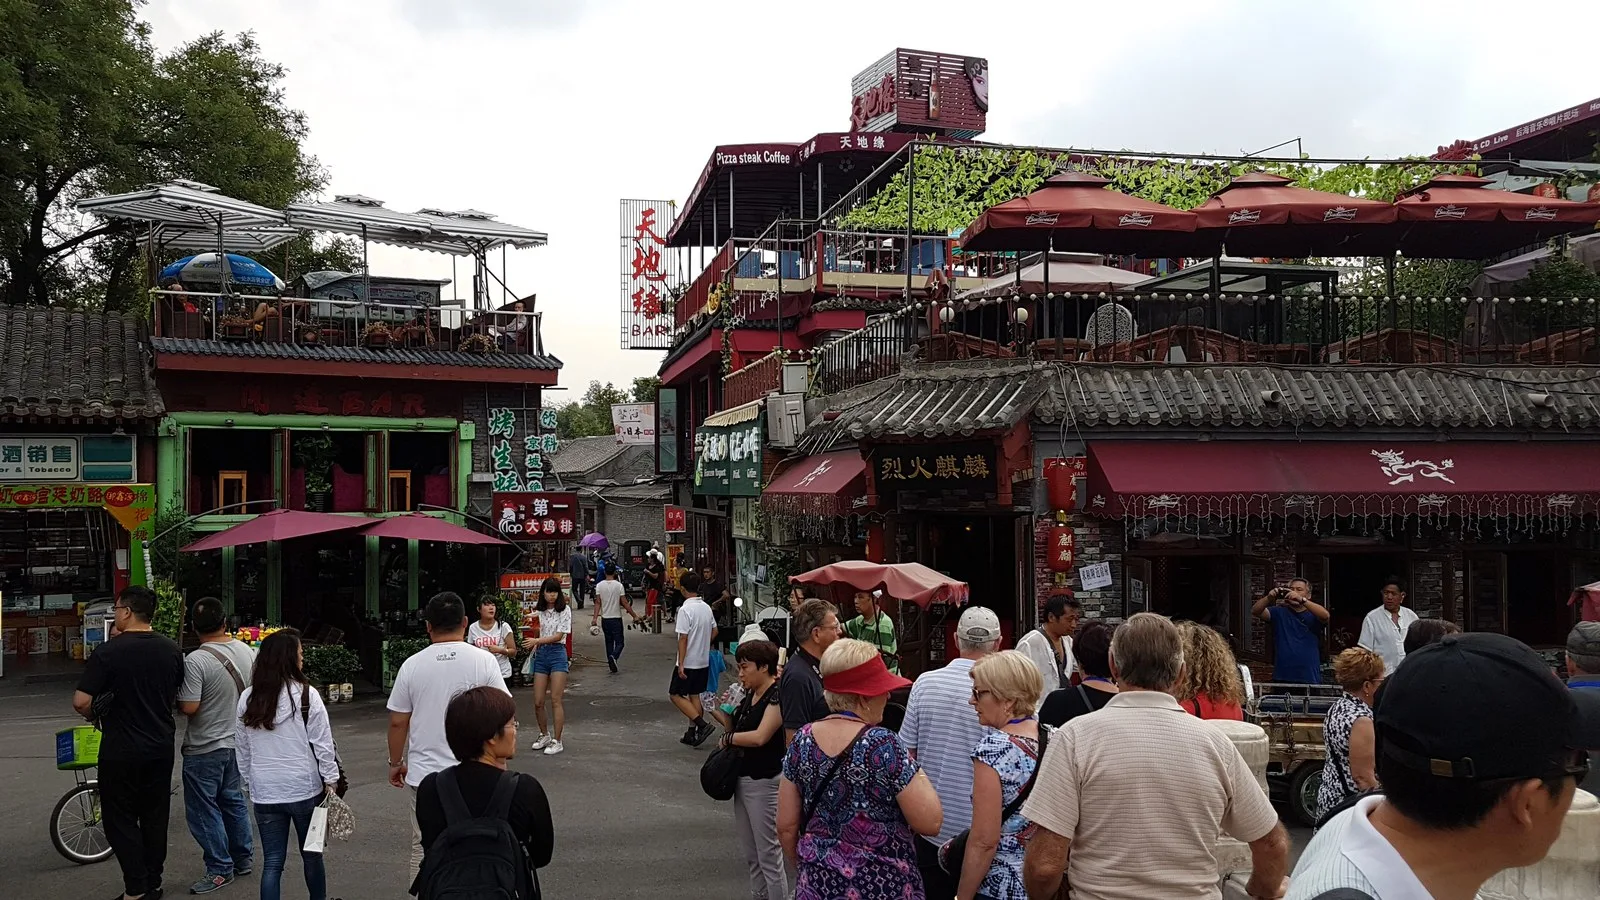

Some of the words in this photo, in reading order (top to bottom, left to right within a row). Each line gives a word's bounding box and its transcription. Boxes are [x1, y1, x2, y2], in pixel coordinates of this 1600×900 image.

[840, 136, 885, 149] 天地缘
[1480, 138, 1491, 149] CD
[1493, 133, 1509, 145] Live
[716, 152, 737, 165] Pizza
[739, 151, 762, 163] steak
[763, 150, 790, 164] Coffee
[631, 324, 668, 337] BAR
[541, 410, 558, 453] 饮料
[2, 445, 72, 463] 酒销售
[881, 455, 989, 480] 烈火麒麟
[35, 486, 103, 504] 宫廷奶酪
[533, 498, 569, 517] 第一
[525, 519, 573, 534] 大鸡排
